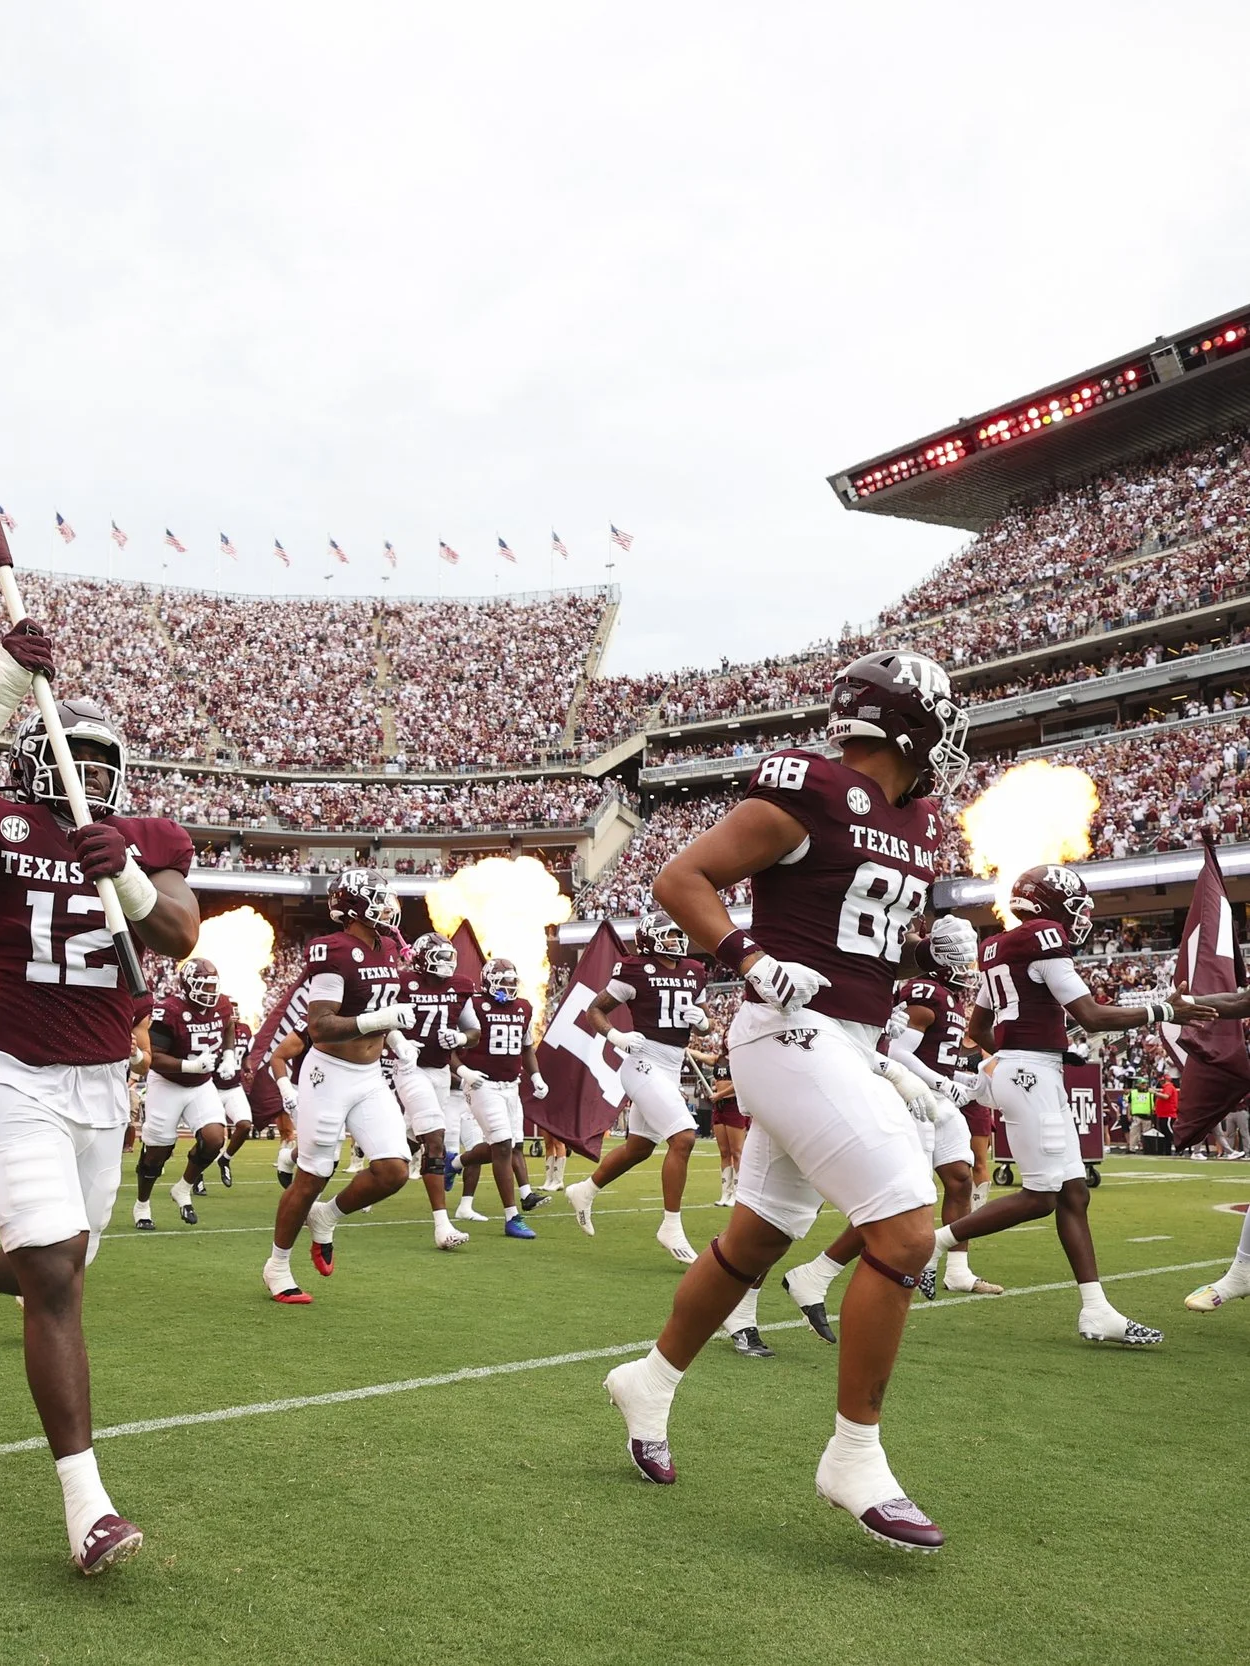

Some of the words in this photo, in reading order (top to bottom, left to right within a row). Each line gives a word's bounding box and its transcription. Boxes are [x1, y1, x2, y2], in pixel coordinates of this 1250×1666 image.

[758, 756, 810, 791] 88
[1, 816, 28, 842] SEC
[849, 824, 910, 863] TEXAS
[1, 850, 85, 885] TEXAS
[836, 861, 929, 964] 88
[26, 890, 120, 989] 12
[1035, 928, 1063, 951] 10
[310, 944, 327, 962] 10
[358, 966, 390, 980] TEXAS
[649, 978, 681, 987] TEXAS
[683, 978, 697, 989] A&M
[410, 994, 439, 1003] TEXAS
[441, 994, 458, 1003] A&M
[911, 983, 936, 999] 27
[186, 1023, 210, 1033] TEXAS
[417, 1004, 449, 1037] 71
[486, 1014, 511, 1022] TEXAS
[489, 1024, 523, 1056] 88
